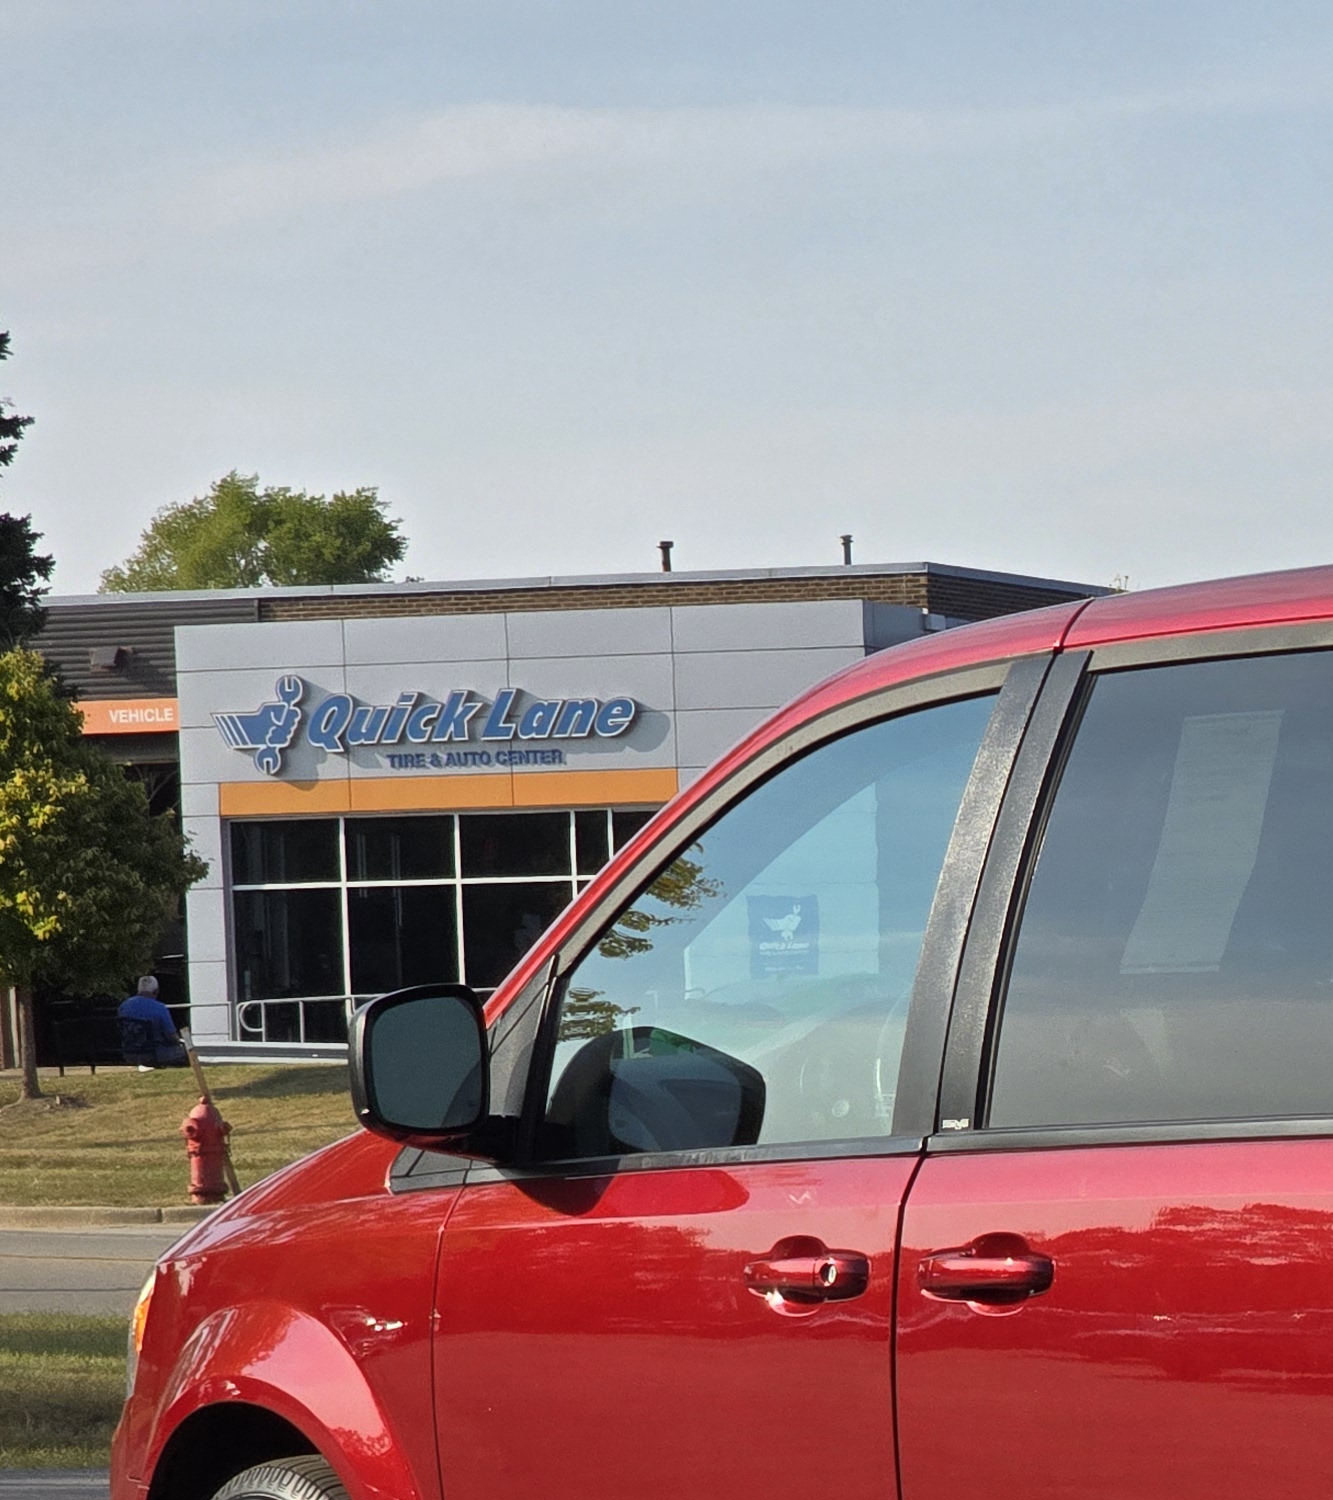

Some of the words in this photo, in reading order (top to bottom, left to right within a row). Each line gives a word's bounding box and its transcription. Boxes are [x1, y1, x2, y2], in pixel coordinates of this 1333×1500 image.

[108, 707, 174, 723] VEHICLE
[306, 690, 483, 753] Quick
[480, 687, 636, 741] Lane
[386, 753, 428, 769] TIRE
[430, 753, 442, 768] &
[445, 751, 492, 768] AUTO
[494, 749, 563, 766] CENTER
